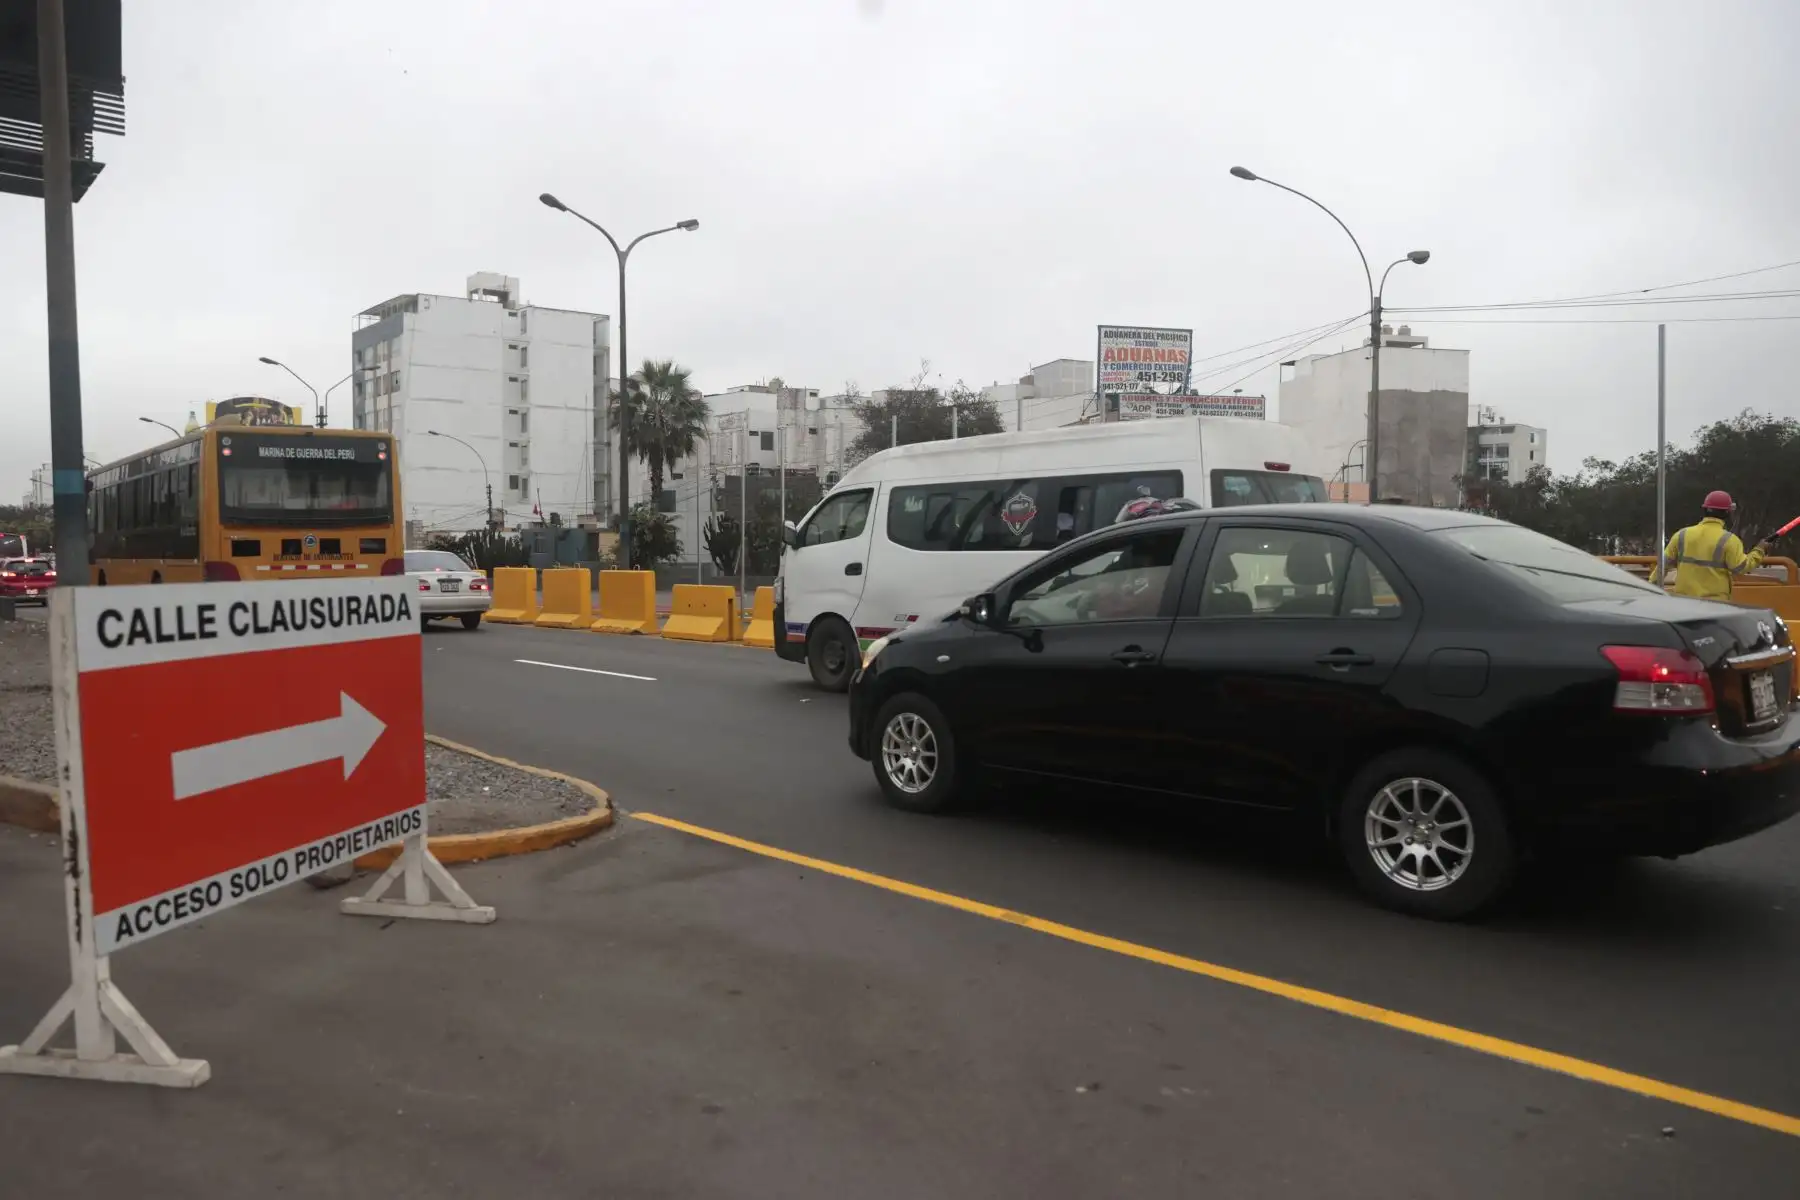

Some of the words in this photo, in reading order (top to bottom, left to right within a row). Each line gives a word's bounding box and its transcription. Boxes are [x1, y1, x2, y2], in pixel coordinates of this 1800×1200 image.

[1104, 330, 1142, 339] ADUANERA
[1143, 332, 1155, 340] DEL
[1104, 347, 1188, 363] ADUANAS
[1110, 363, 1153, 371] COMERCIO
[1154, 363, 1187, 371] EXTERIO
[1172, 395, 1220, 404] COMERCIO
[1222, 397, 1263, 405] EXTERIOR
[259, 446, 285, 457] MARINA
[285, 447, 296, 458] DE
[296, 448, 324, 459] GUERRA
[324, 448, 337, 459] DEL
[338, 447, 355, 460] PERÚ
[96, 603, 218, 649] CALLE
[227, 592, 412, 637] CLAUSURADA
[115, 880, 223, 942] ACCESO
[229, 857, 289, 898] SOLO
[295, 809, 422, 875] PROPIETARIOS
